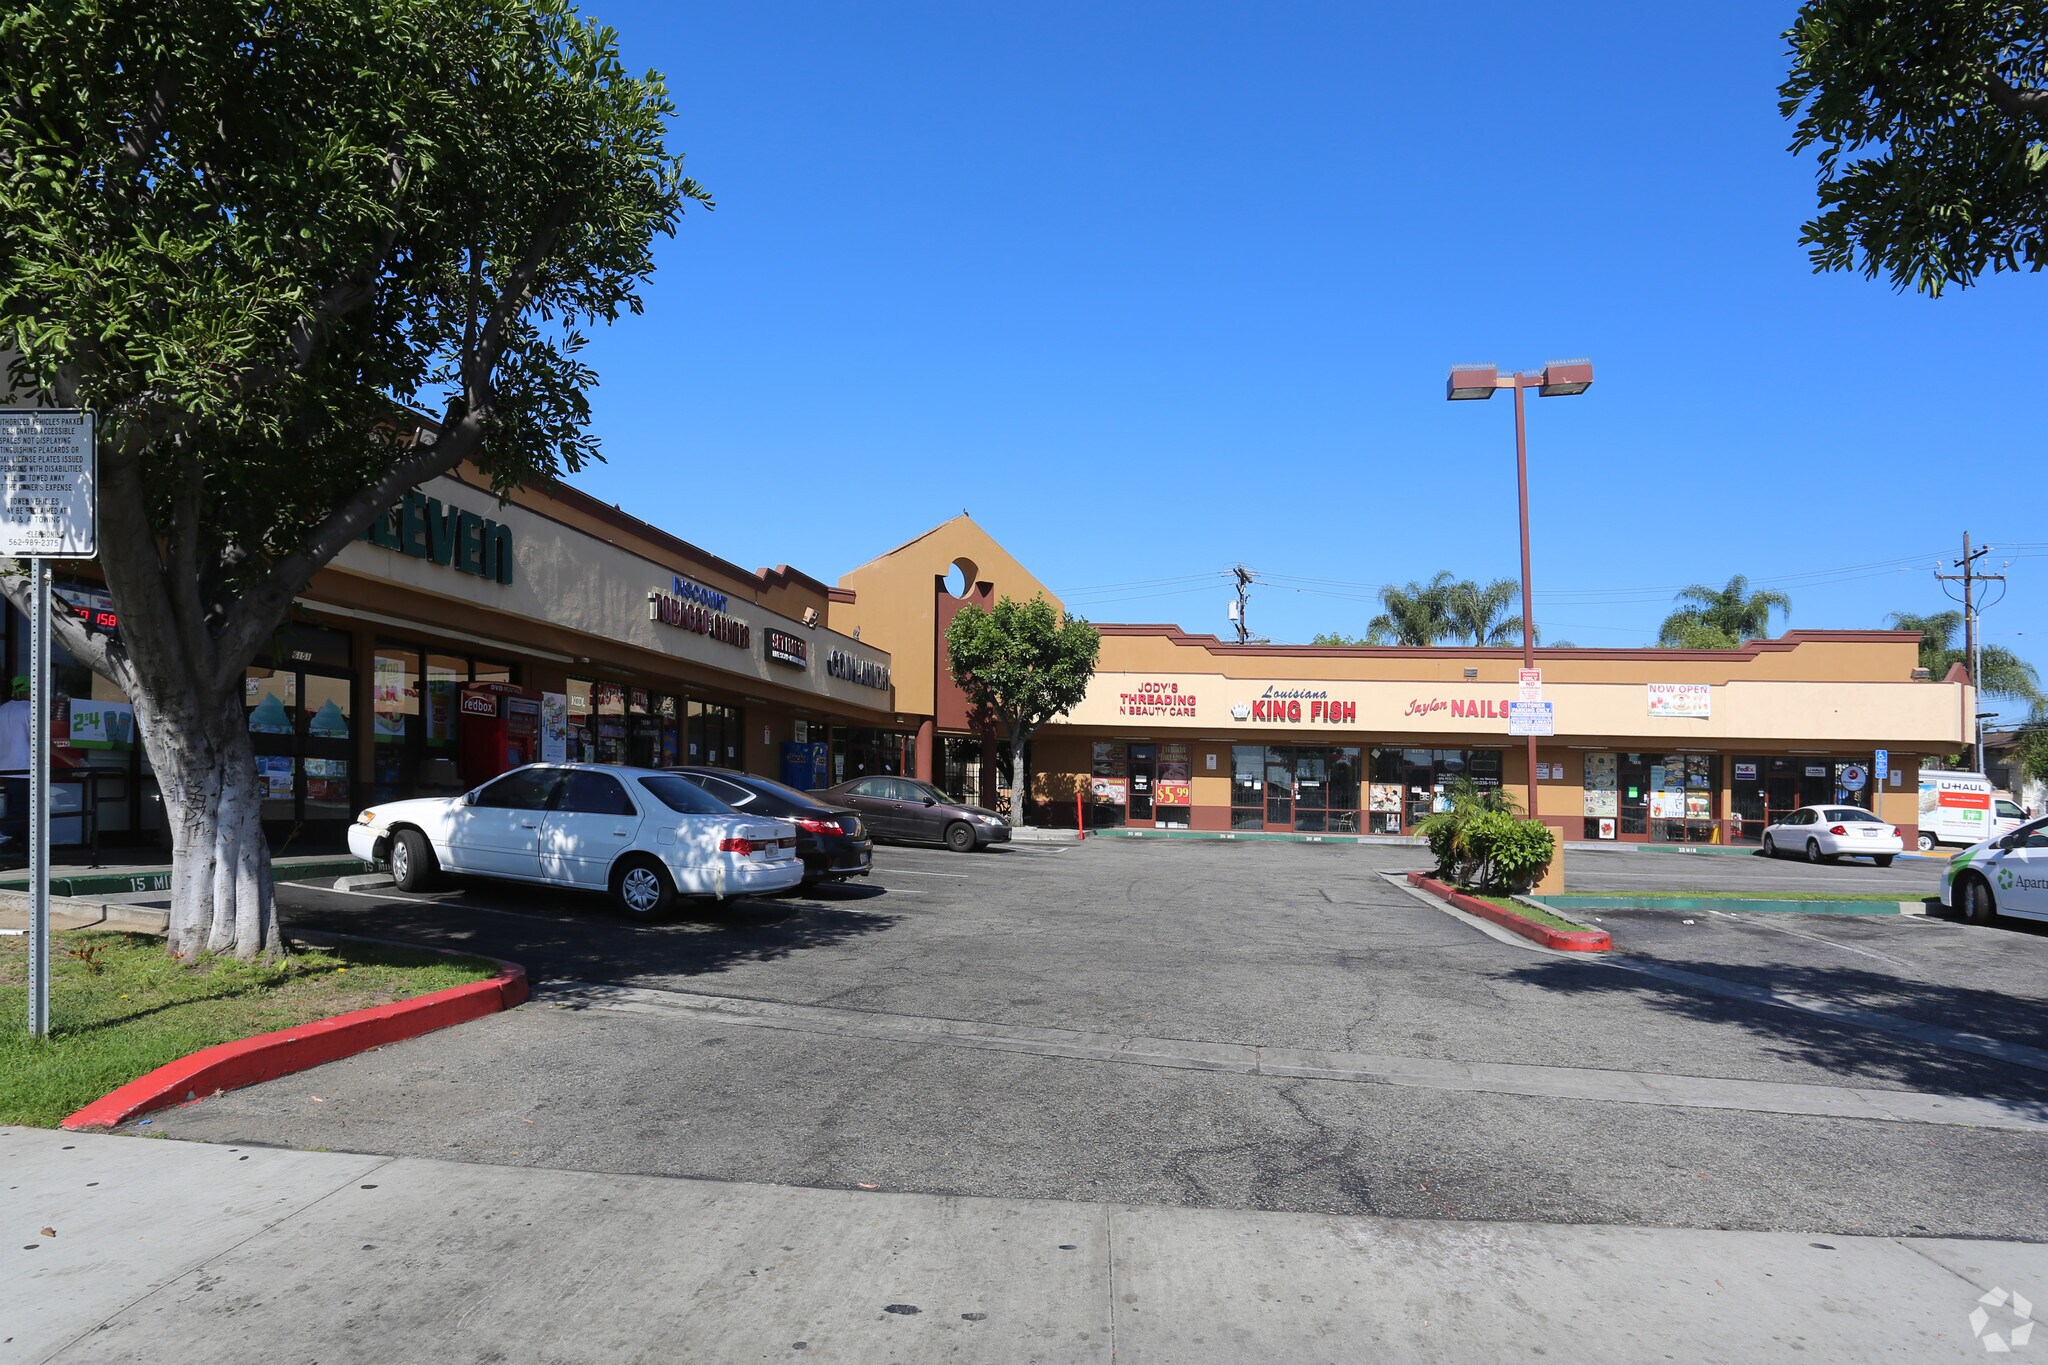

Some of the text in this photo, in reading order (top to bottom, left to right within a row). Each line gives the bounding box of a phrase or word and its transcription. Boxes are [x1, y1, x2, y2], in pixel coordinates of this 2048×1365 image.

[648, 592, 710, 636] TOBACCO
[711, 613, 749, 649] CENTER
[1138, 682, 1178, 693] JODY'S
[1262, 685, 1328, 698] Louisiana
[464, 698, 492, 713] redbox
[1120, 694, 1196, 706] THREADING
[1404, 698, 1448, 716] Jaylen
[1120, 706, 1196, 717] N BEAUTY CARE
[1252, 700, 1356, 724] KING FISH
[1451, 700, 1508, 718] NAILS
[1942, 782, 1984, 791] U-HAUL
[1158, 786, 1189, 803] $5.99
[131, 876, 172, 891] 15 MI
[2016, 874, 2048, 890] Apart
